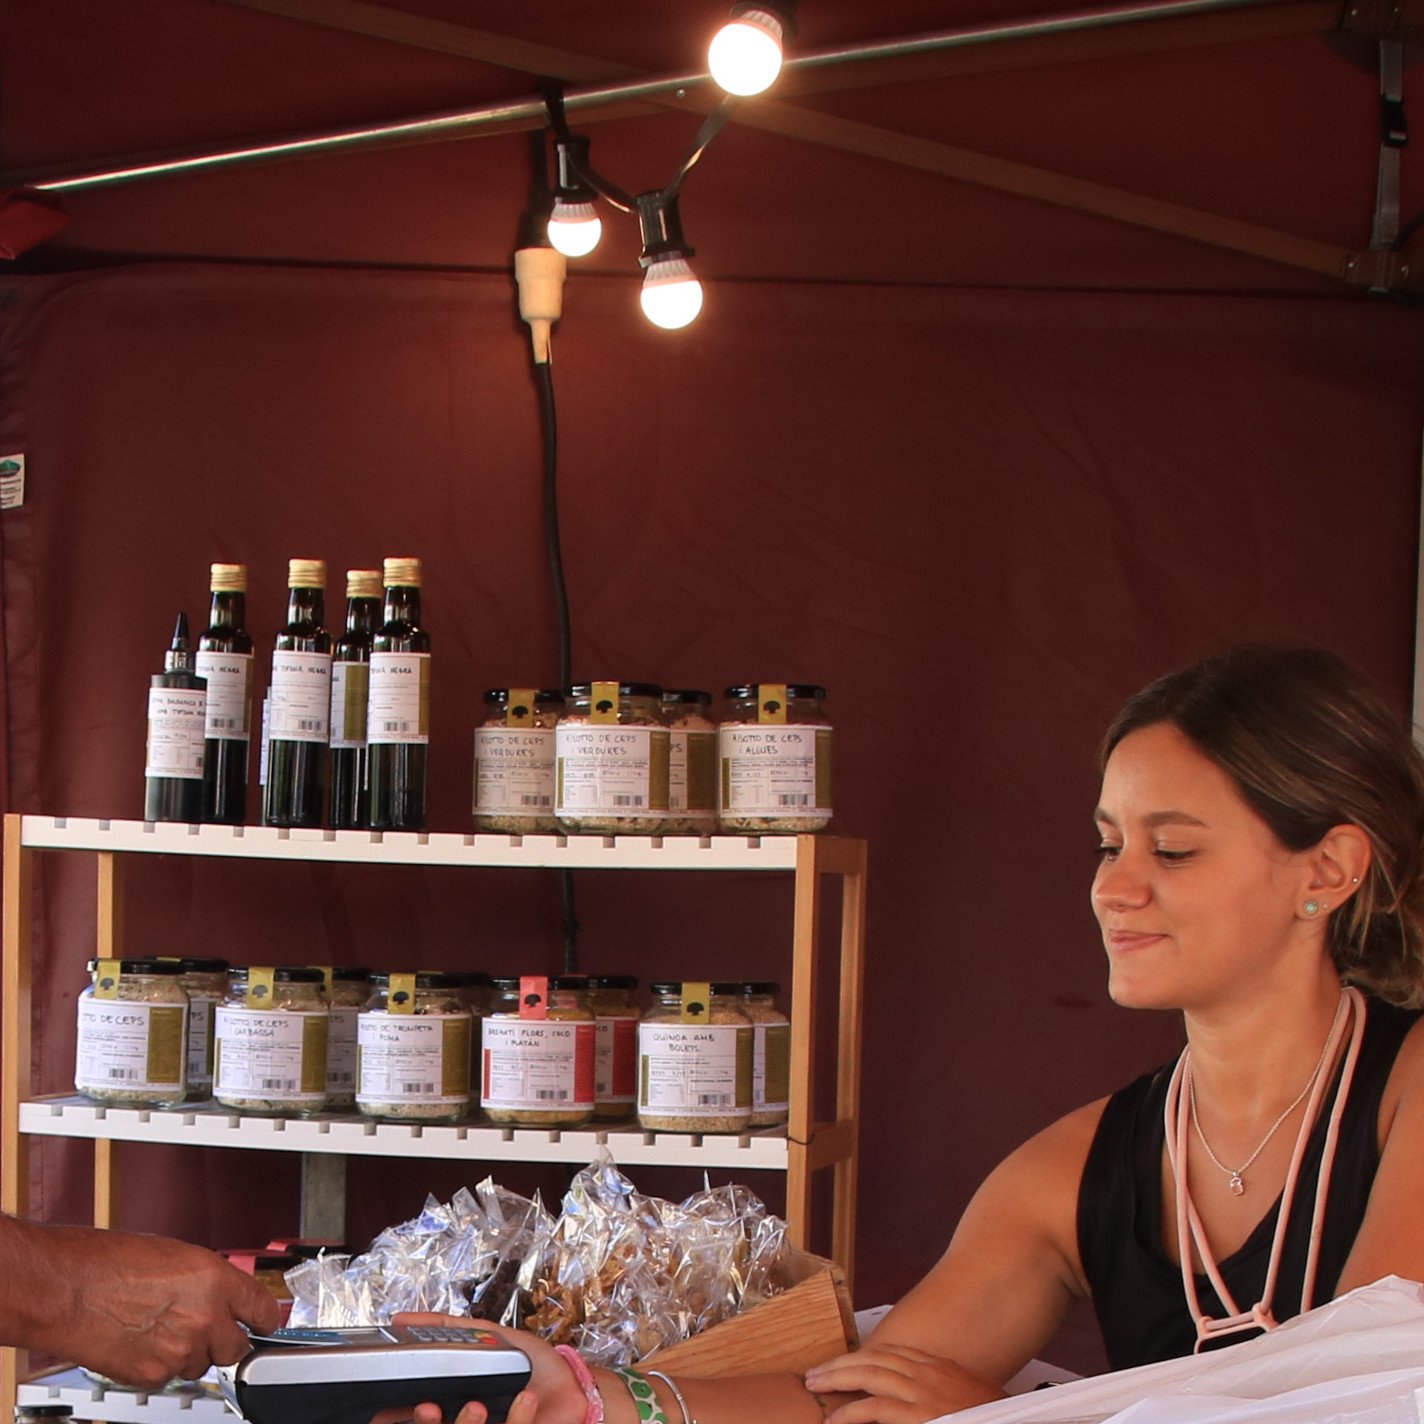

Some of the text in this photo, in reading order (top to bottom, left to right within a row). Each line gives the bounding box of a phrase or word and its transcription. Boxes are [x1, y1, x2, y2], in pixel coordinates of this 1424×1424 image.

[508, 737, 520, 745] DE
[523, 737, 545, 746] CEPS
[565, 734, 636, 744] RISOTTO DE CEPS
[732, 733, 802, 743] RISOTTO DE CEPS
[578, 746, 627, 755] VERDURES
[745, 746, 778, 755] ALGUES
[100, 1014, 113, 1024] DE
[115, 1014, 144, 1026] CEPS
[253, 1019, 264, 1027] DE
[266, 1020, 289, 1028] CEPS
[552, 1029, 571, 1038] COCO
[693, 1033, 715, 1042] AMB
[668, 1043, 700, 1053] BOLETS
